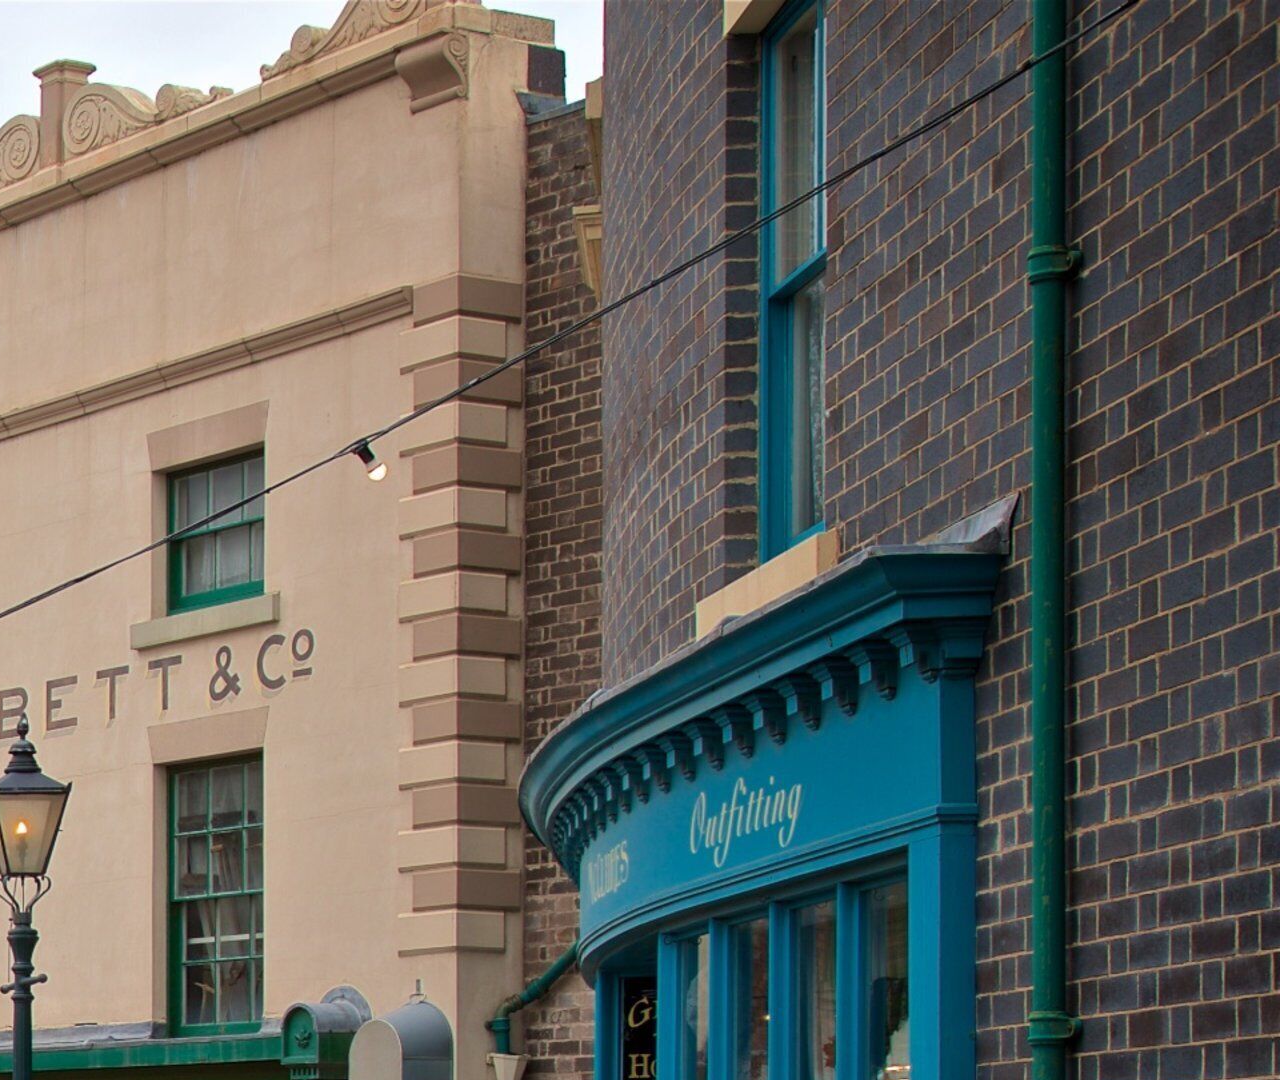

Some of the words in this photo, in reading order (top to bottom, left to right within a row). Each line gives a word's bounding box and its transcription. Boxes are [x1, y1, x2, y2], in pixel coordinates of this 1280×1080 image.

[209, 645, 242, 701] &
[690, 776, 802, 868] Outfitting
[628, 996, 657, 1028] G
